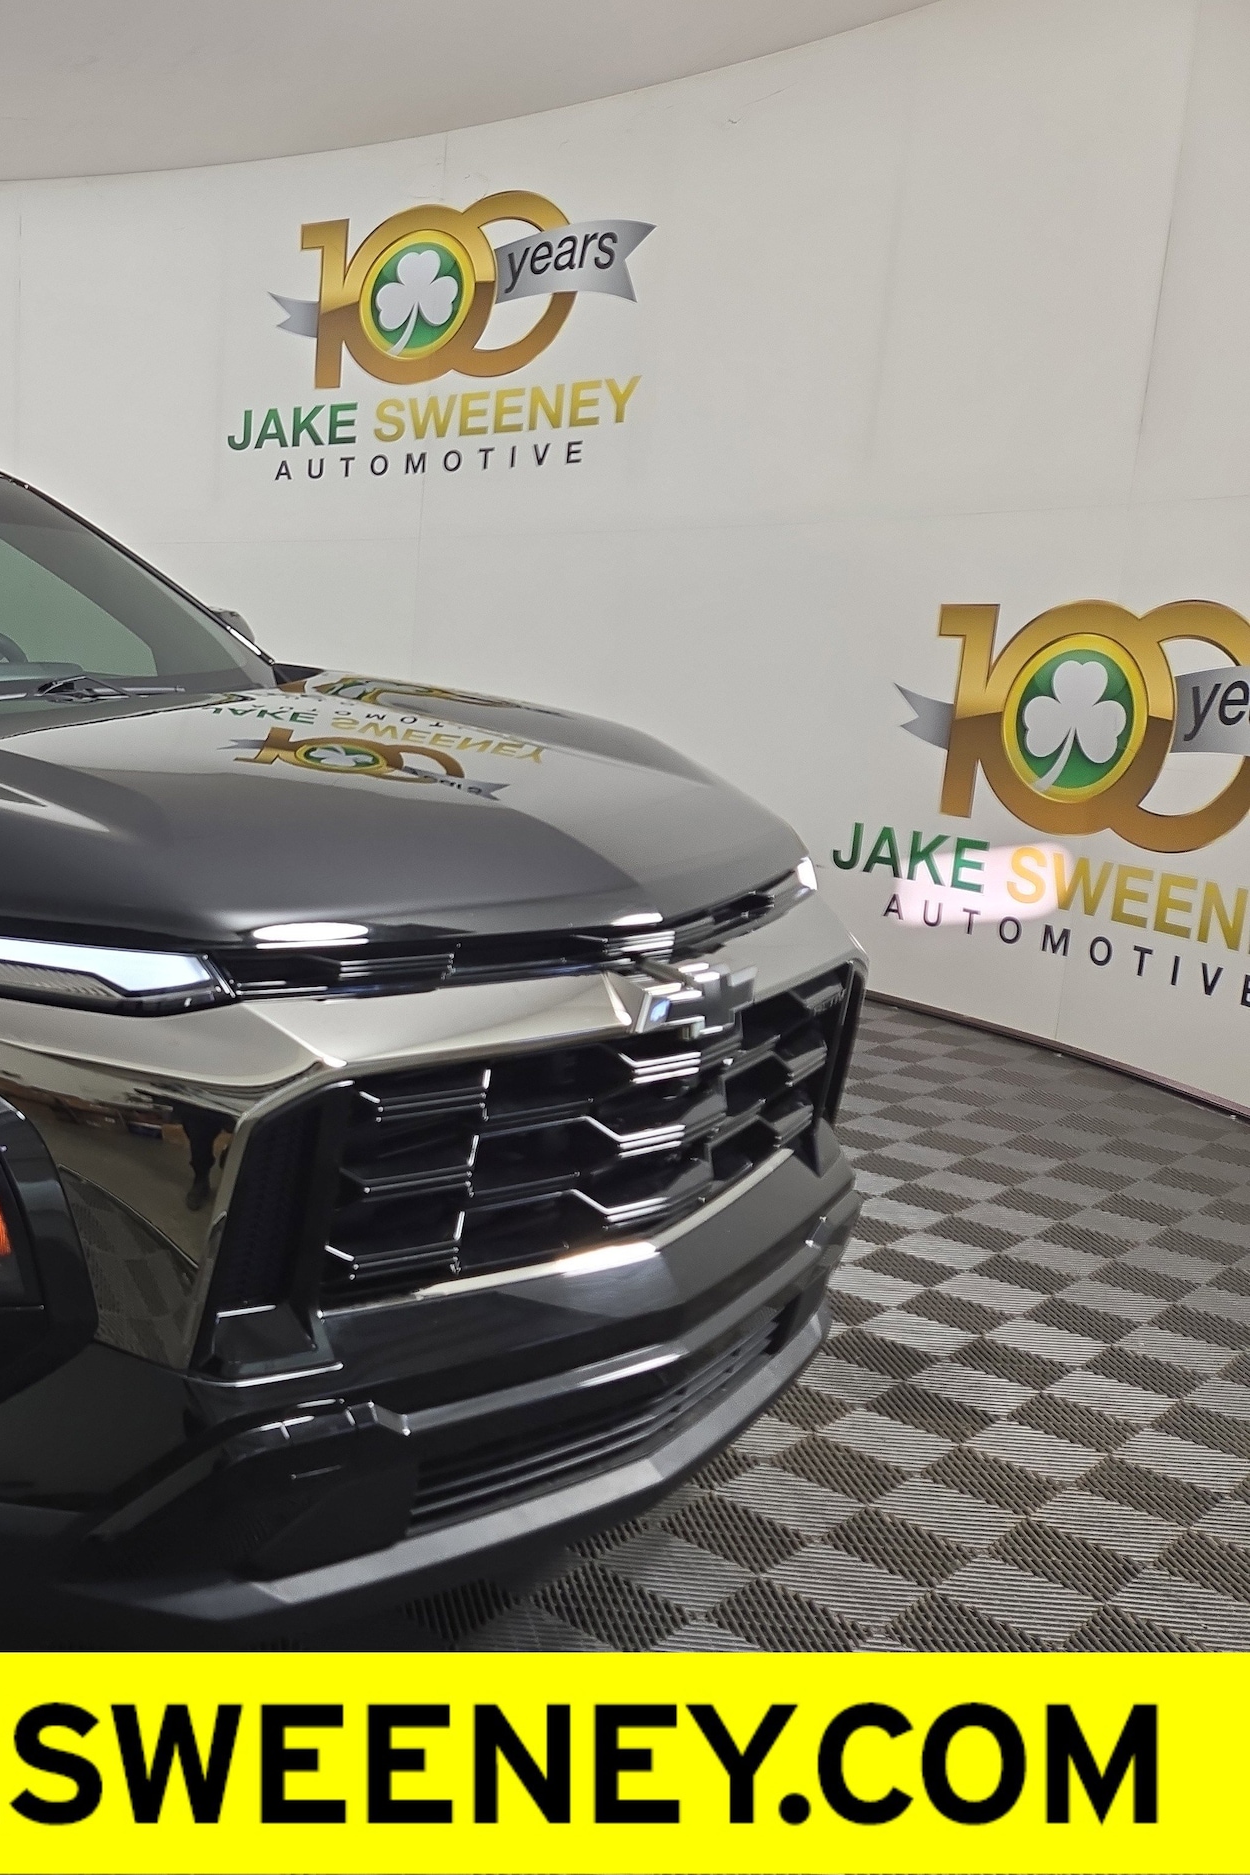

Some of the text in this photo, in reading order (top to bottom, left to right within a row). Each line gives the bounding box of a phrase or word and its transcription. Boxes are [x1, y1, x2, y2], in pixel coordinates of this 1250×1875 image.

[505, 230, 617, 294] years
[227, 375, 643, 451] JAKE SWEENEY
[275, 441, 583, 481] AUTOMOTIVE
[1183, 680, 1250, 742] ye
[832, 821, 1250, 955] JAKE SWEEN
